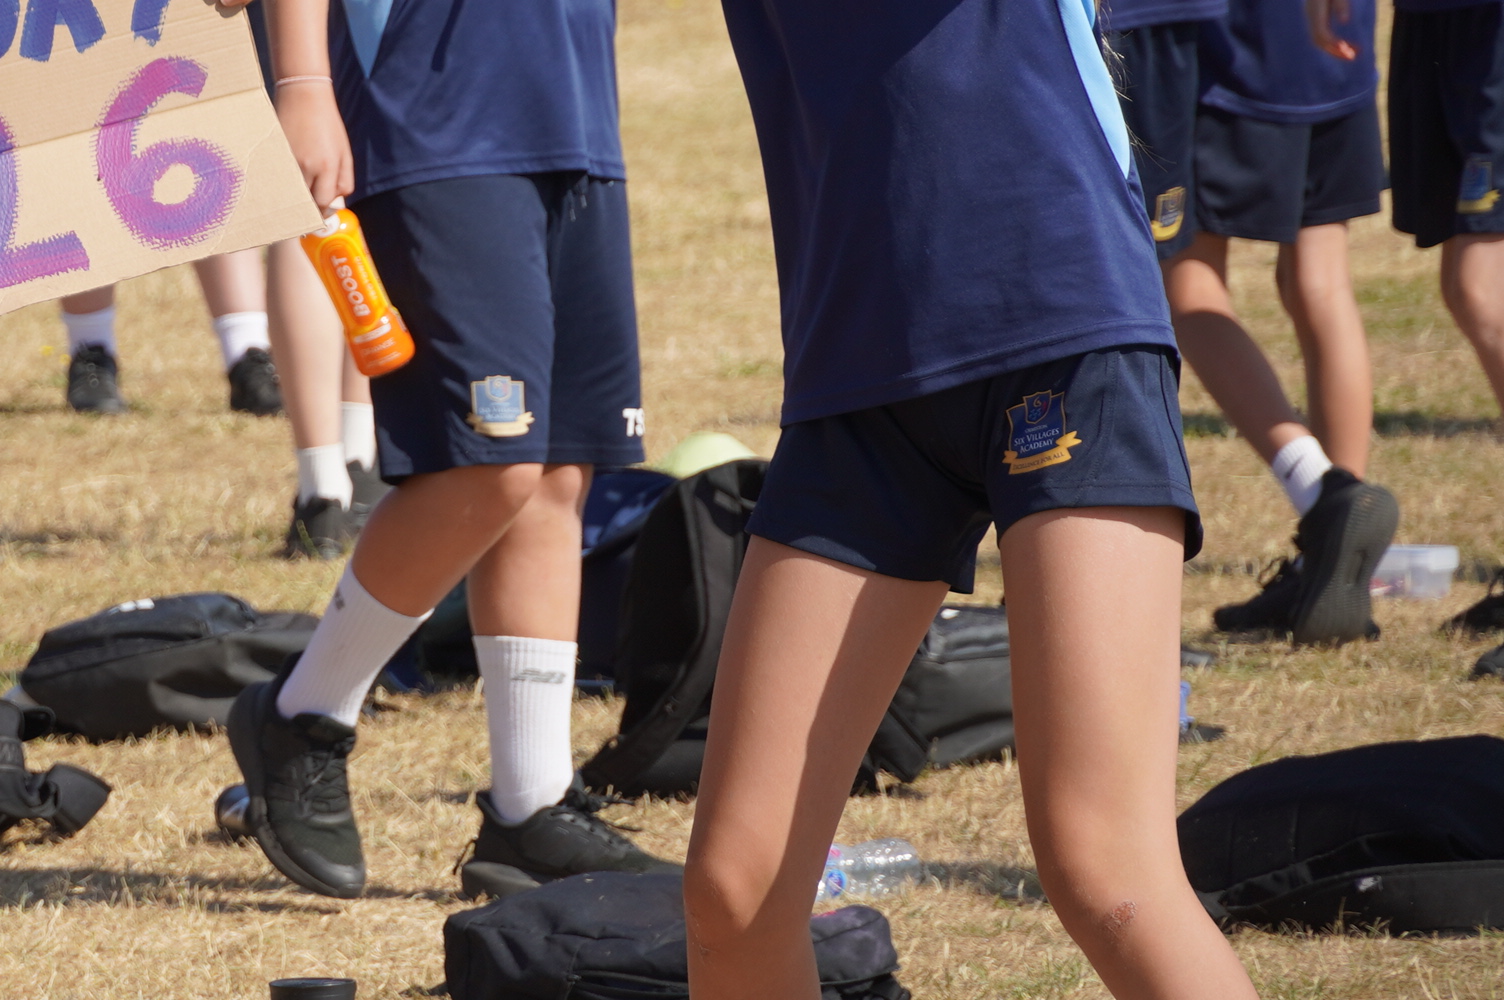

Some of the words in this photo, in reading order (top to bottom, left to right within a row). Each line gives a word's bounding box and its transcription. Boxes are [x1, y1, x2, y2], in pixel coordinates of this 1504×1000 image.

[330, 255, 371, 317] BOOST
[1014, 437, 1025, 446] SIX
[1026, 428, 1059, 441] VILLAGES
[1020, 439, 1053, 453] ACADEMY
